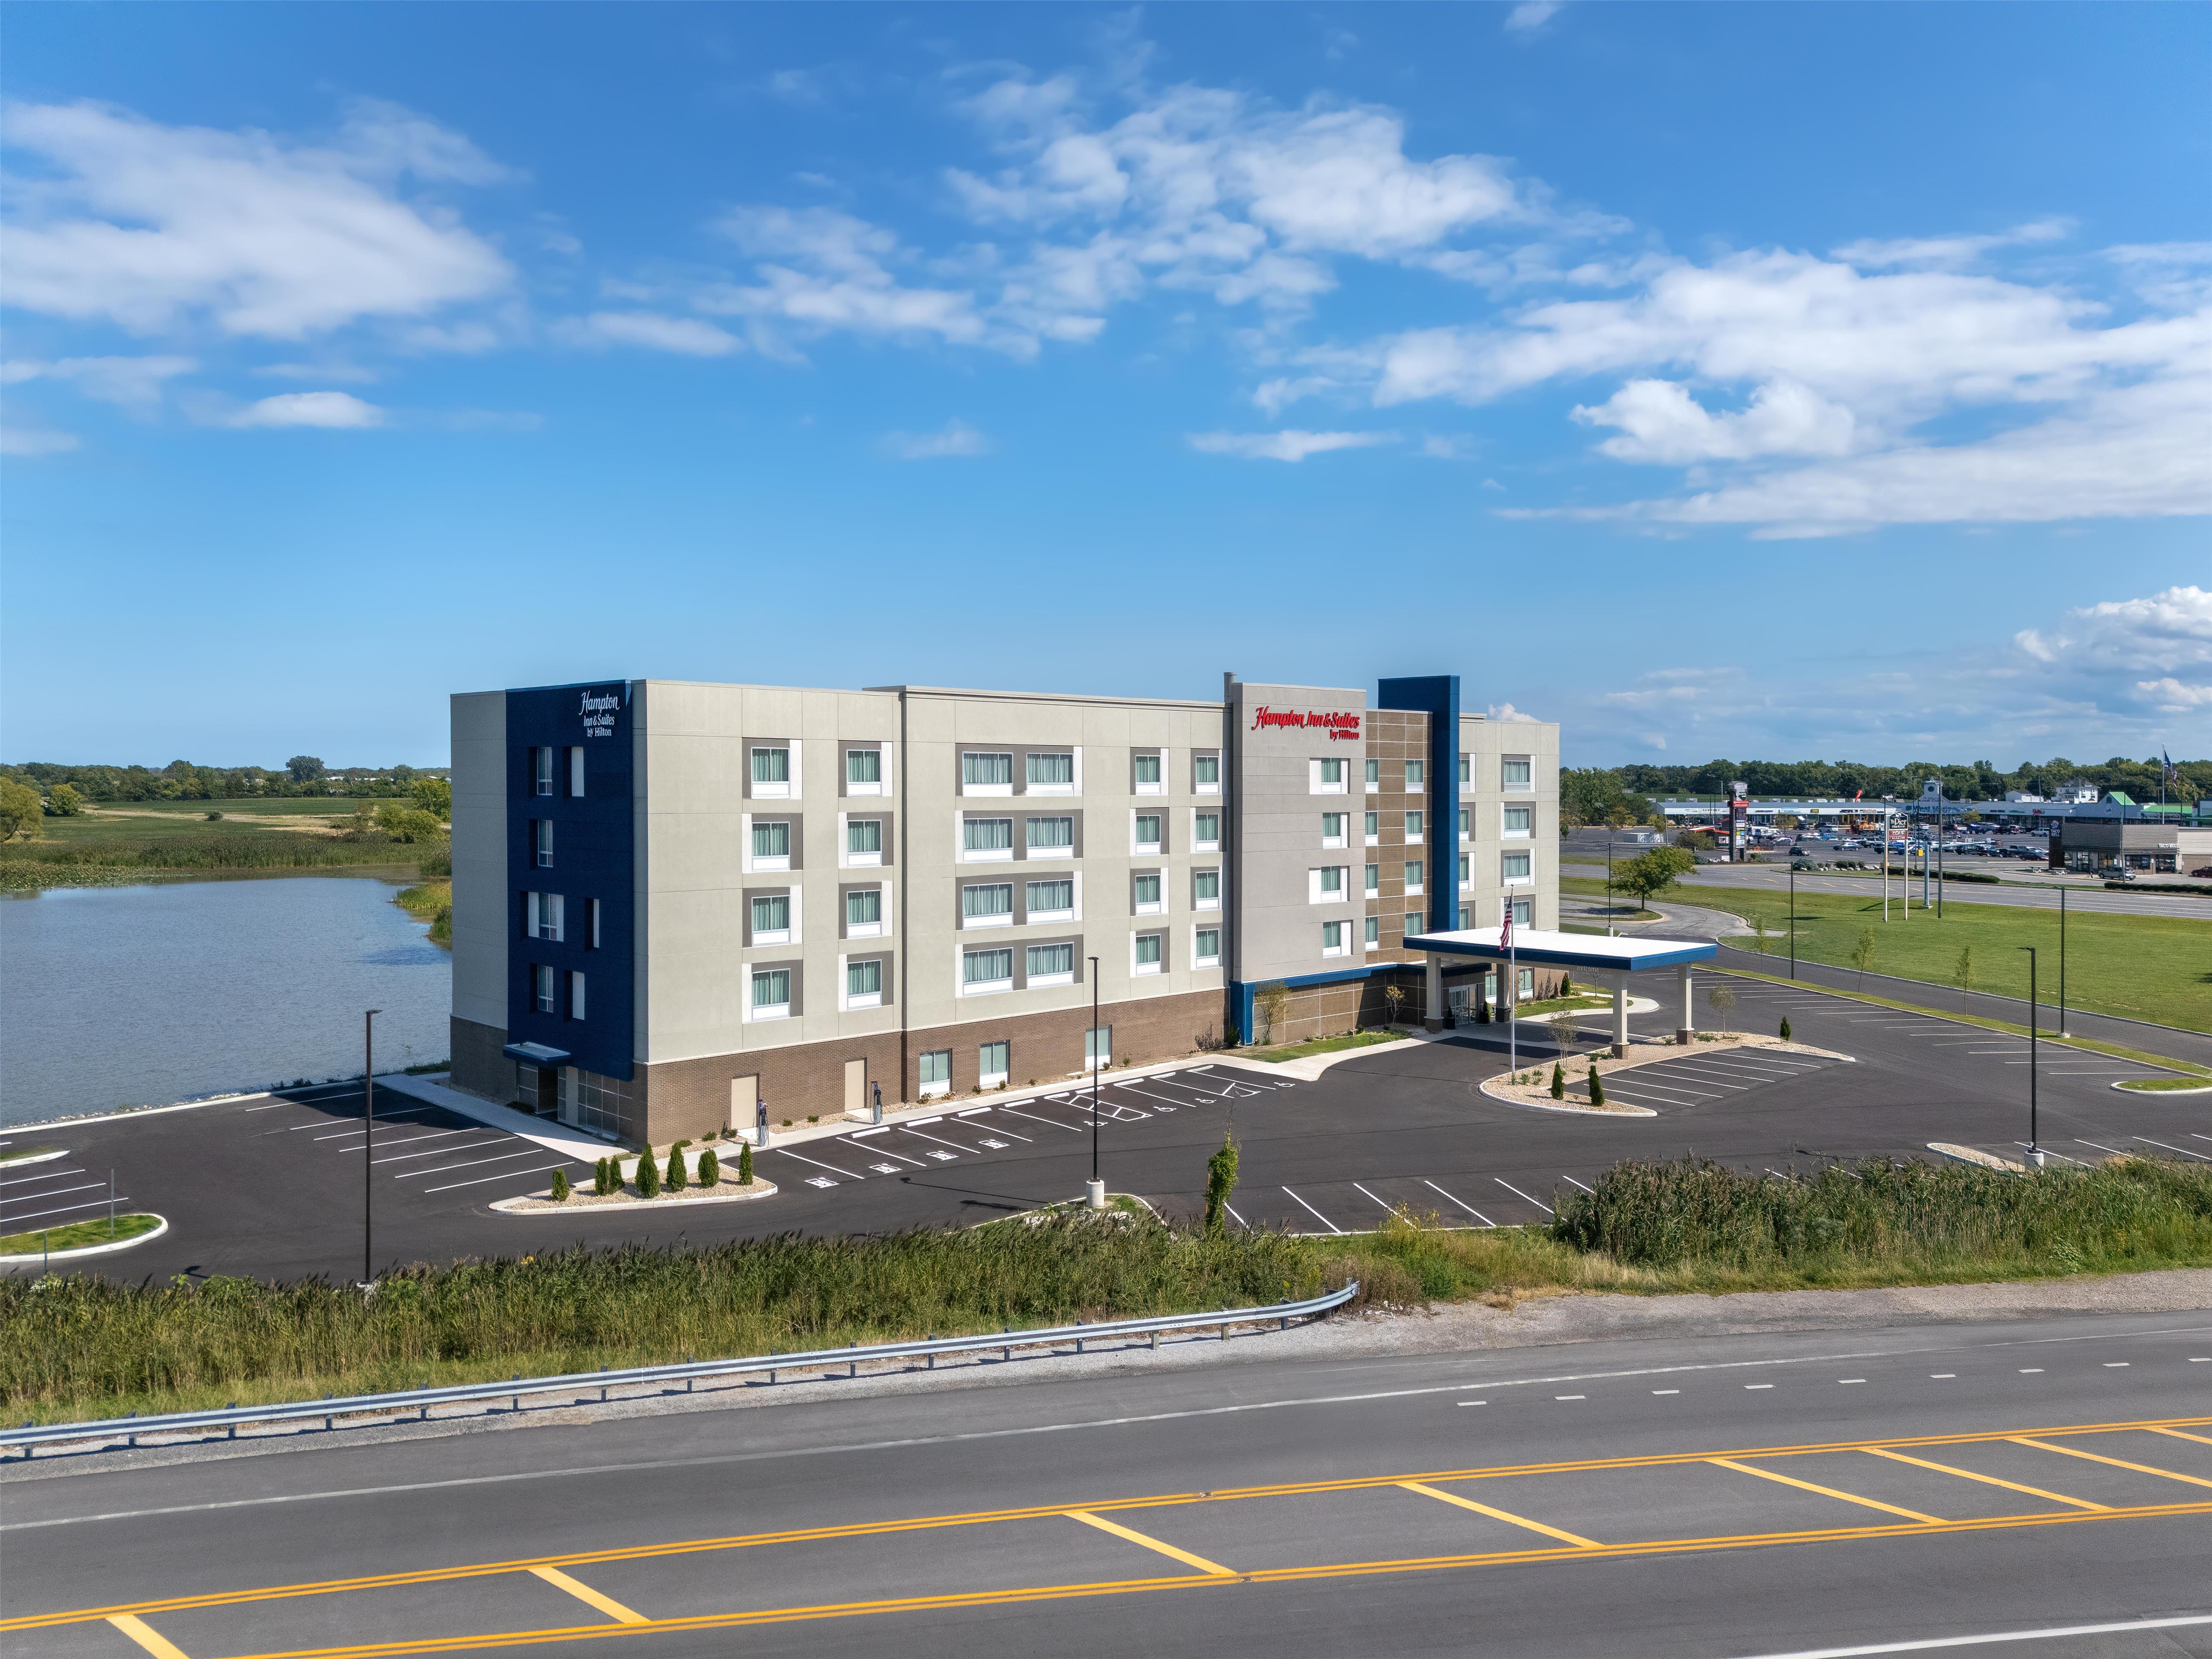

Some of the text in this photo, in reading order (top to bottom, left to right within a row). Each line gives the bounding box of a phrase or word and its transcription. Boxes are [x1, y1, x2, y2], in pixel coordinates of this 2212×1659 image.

[579, 690, 620, 715] Hampton
[1251, 706, 1305, 730] Hampton
[587, 727, 611, 737] by Hilton
[1329, 729, 1360, 741] by Hilton
